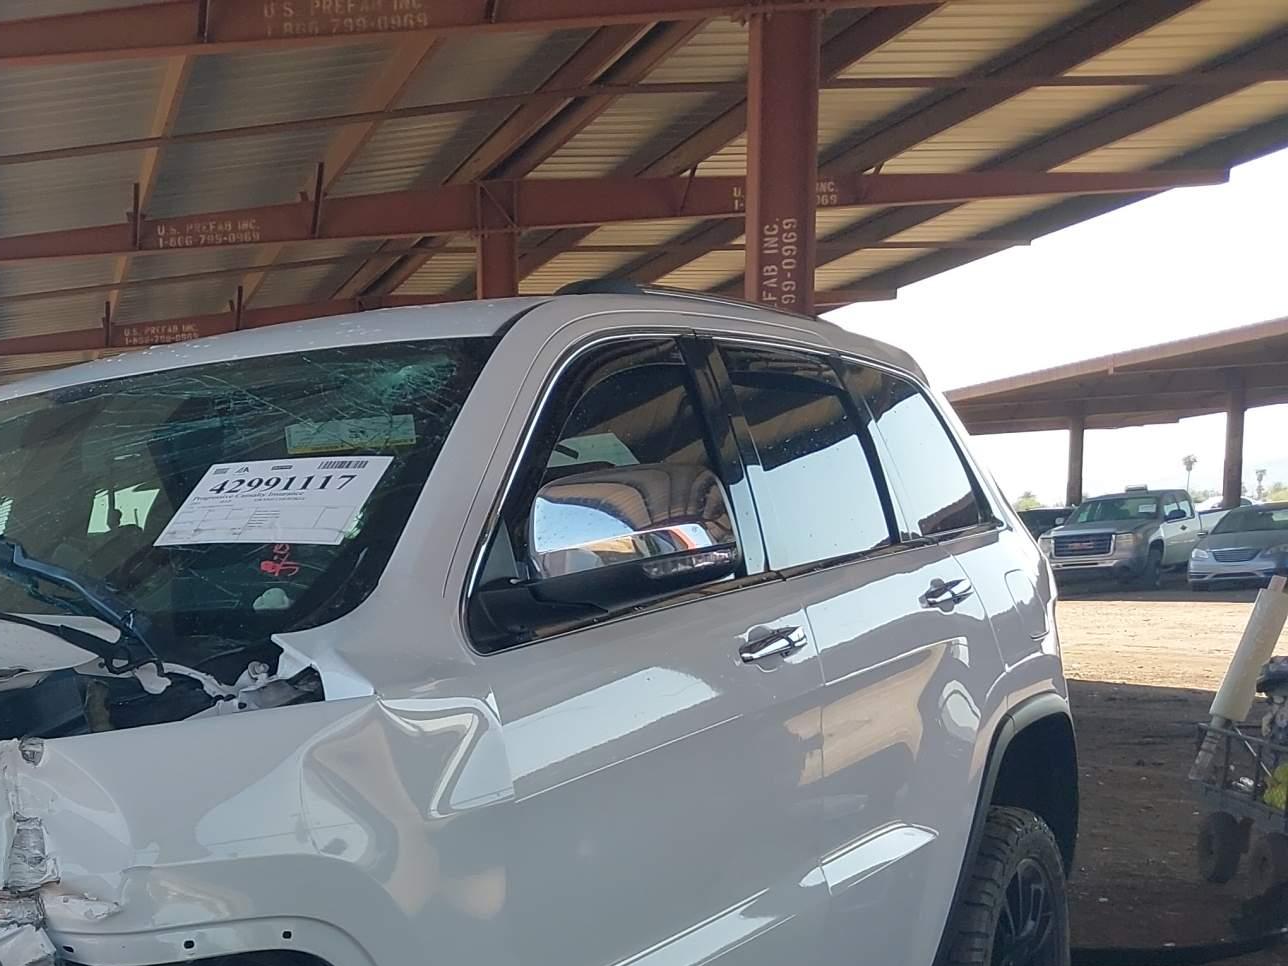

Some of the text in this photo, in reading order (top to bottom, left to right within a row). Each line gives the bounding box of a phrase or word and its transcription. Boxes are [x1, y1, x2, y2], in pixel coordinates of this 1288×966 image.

[781, 218, 798, 304] 99-0969
[762, 265, 779, 305] FAB
[209, 474, 357, 494] 42991117
